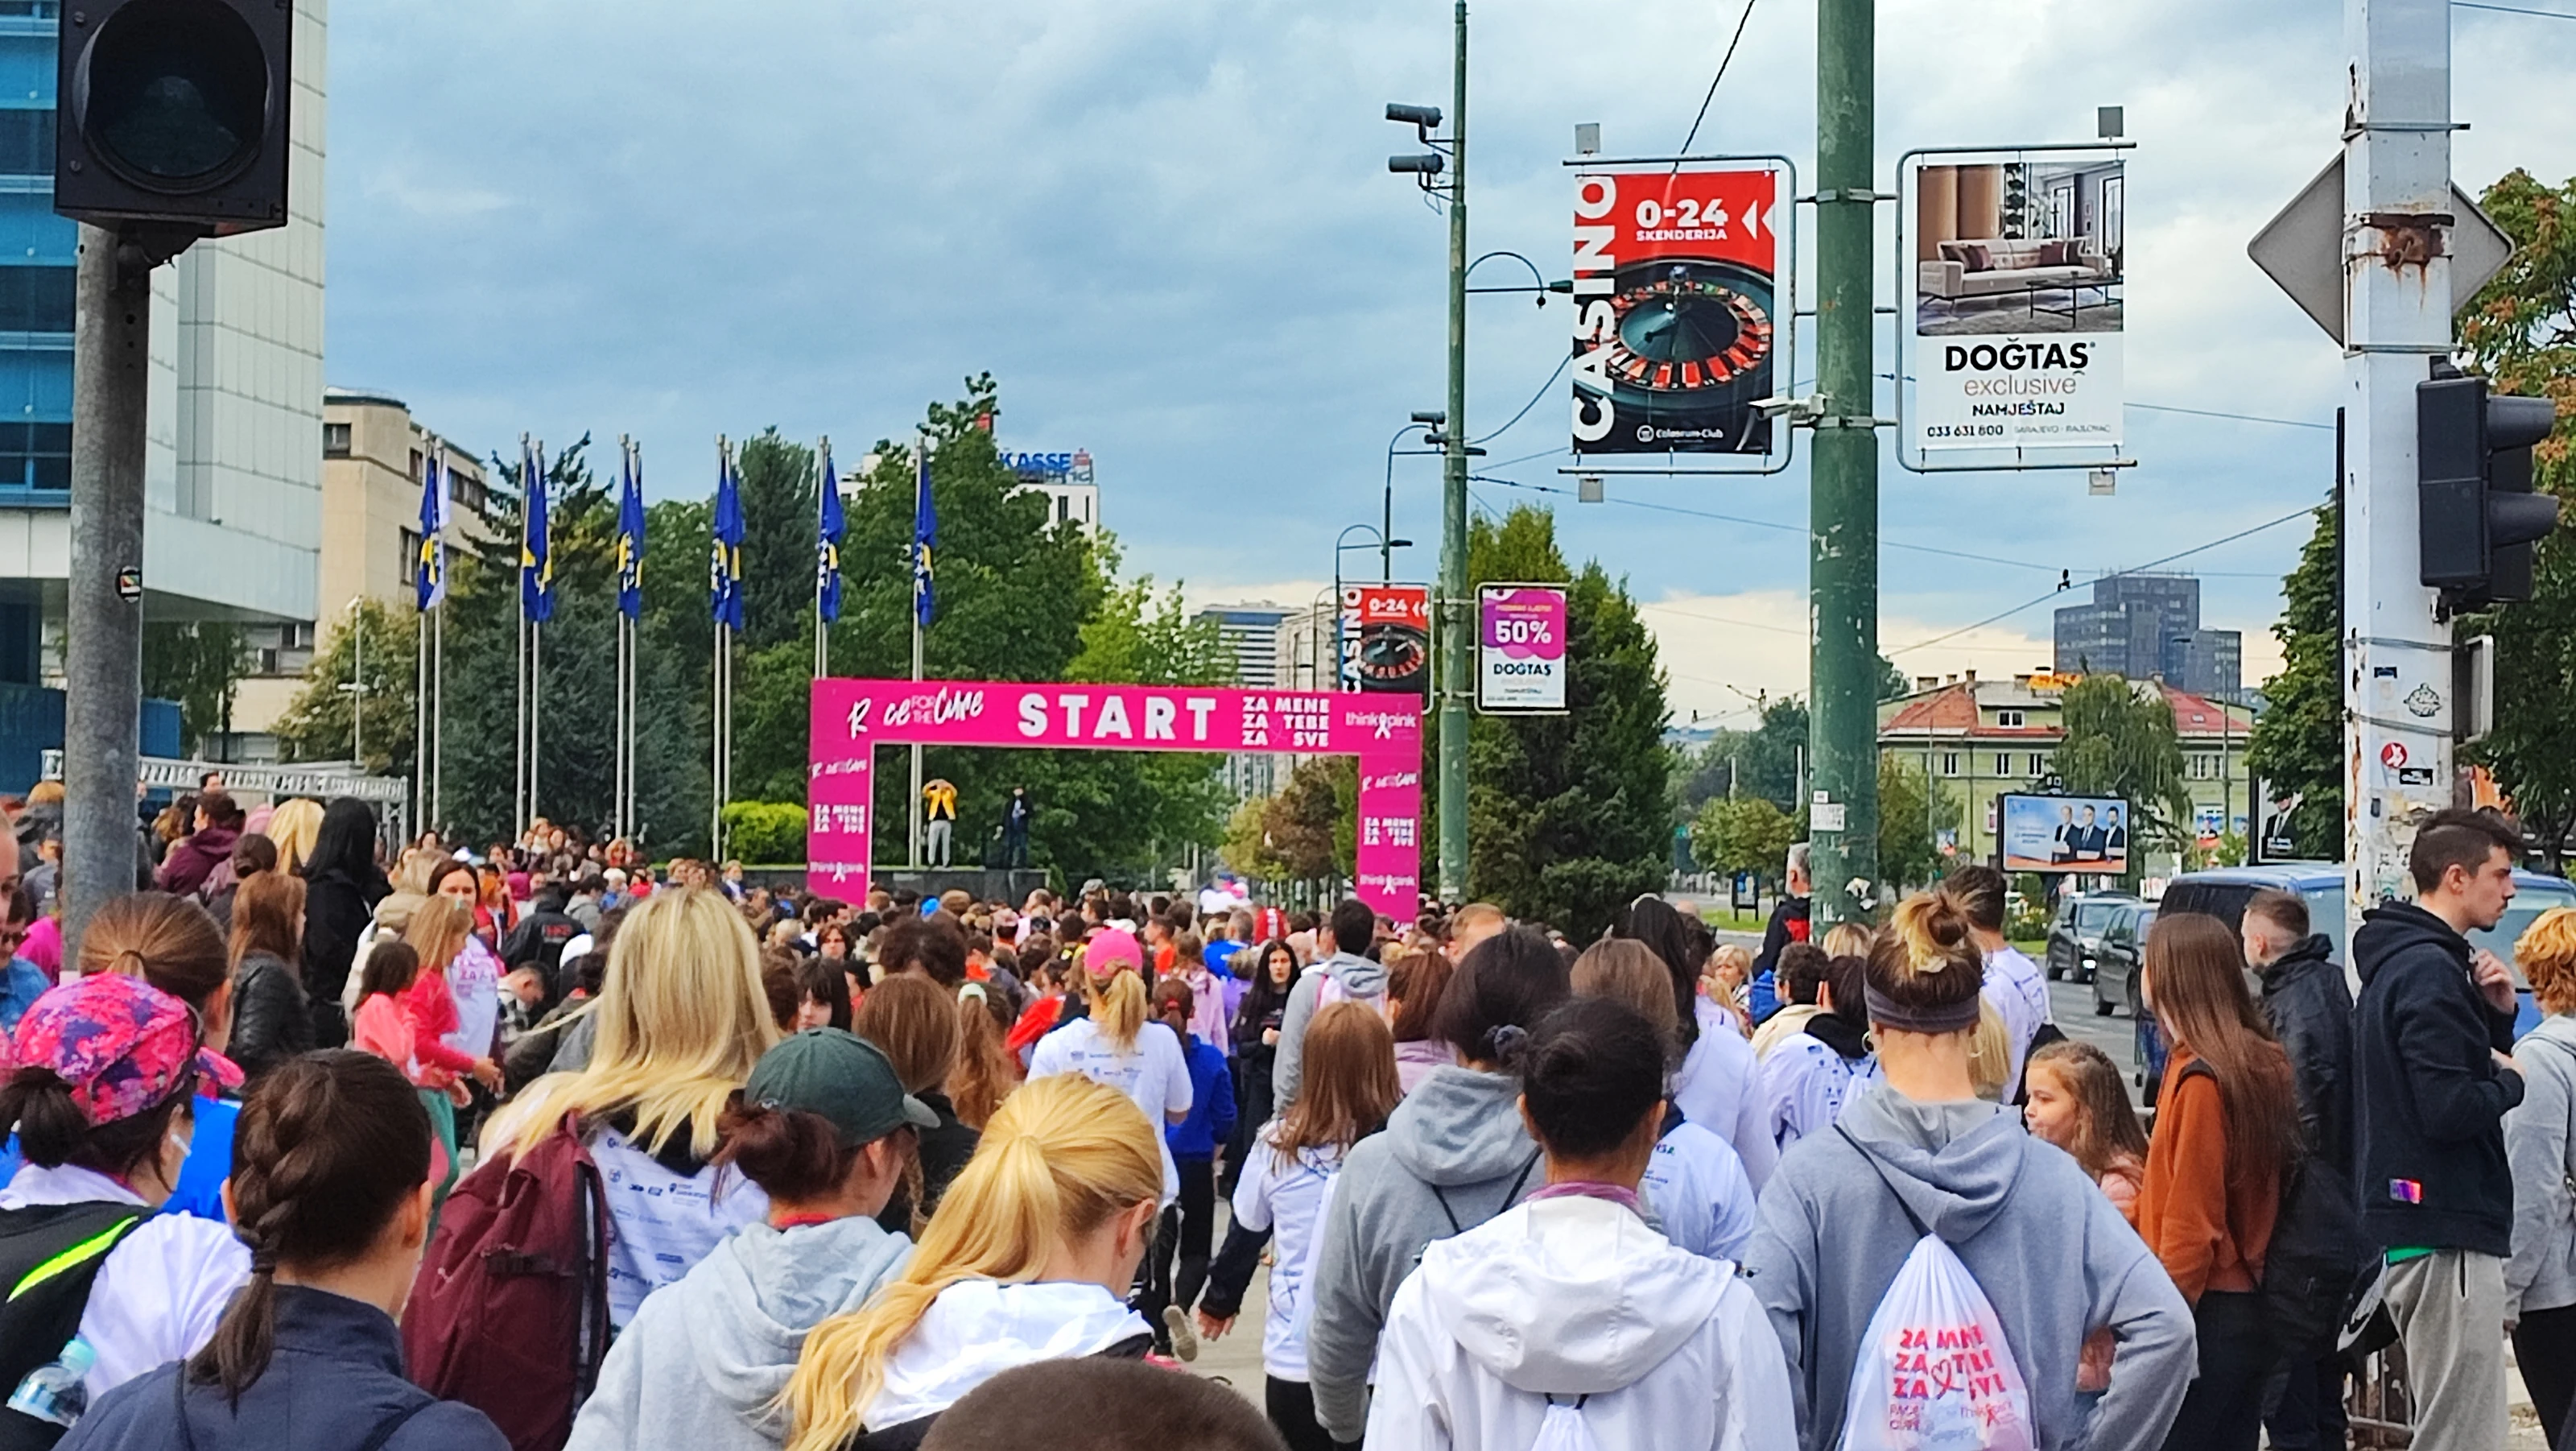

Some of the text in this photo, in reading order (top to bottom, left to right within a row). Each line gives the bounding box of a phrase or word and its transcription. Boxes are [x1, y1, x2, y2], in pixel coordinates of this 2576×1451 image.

[1636, 198, 1728, 229] 0-24
[1636, 229, 1728, 242] SKENDERIJA
[1572, 175, 1616, 442] CASINO
[1964, 374, 2077, 396] exclusive
[1972, 400, 2065, 417] NAMJEŠTAJ
[1927, 426, 1951, 437] 033
[1954, 425, 1975, 436] 631
[1978, 424, 2004, 436] 800
[1368, 597, 1408, 612] 0-24
[1495, 619, 1553, 644] 50%
[911, 695, 936, 709] FOR
[1242, 697, 1331, 713] ZA MENE
[913, 709, 934, 725] THE
[1018, 692, 1217, 742] START
[1242, 713, 1330, 730] ZA TEBE
[1242, 730, 1330, 747] ZA SVE
[1900, 1329, 1929, 1351] ZA
[1894, 1352, 1929, 1376] ZA
[1893, 1377, 1930, 1400] ZA
